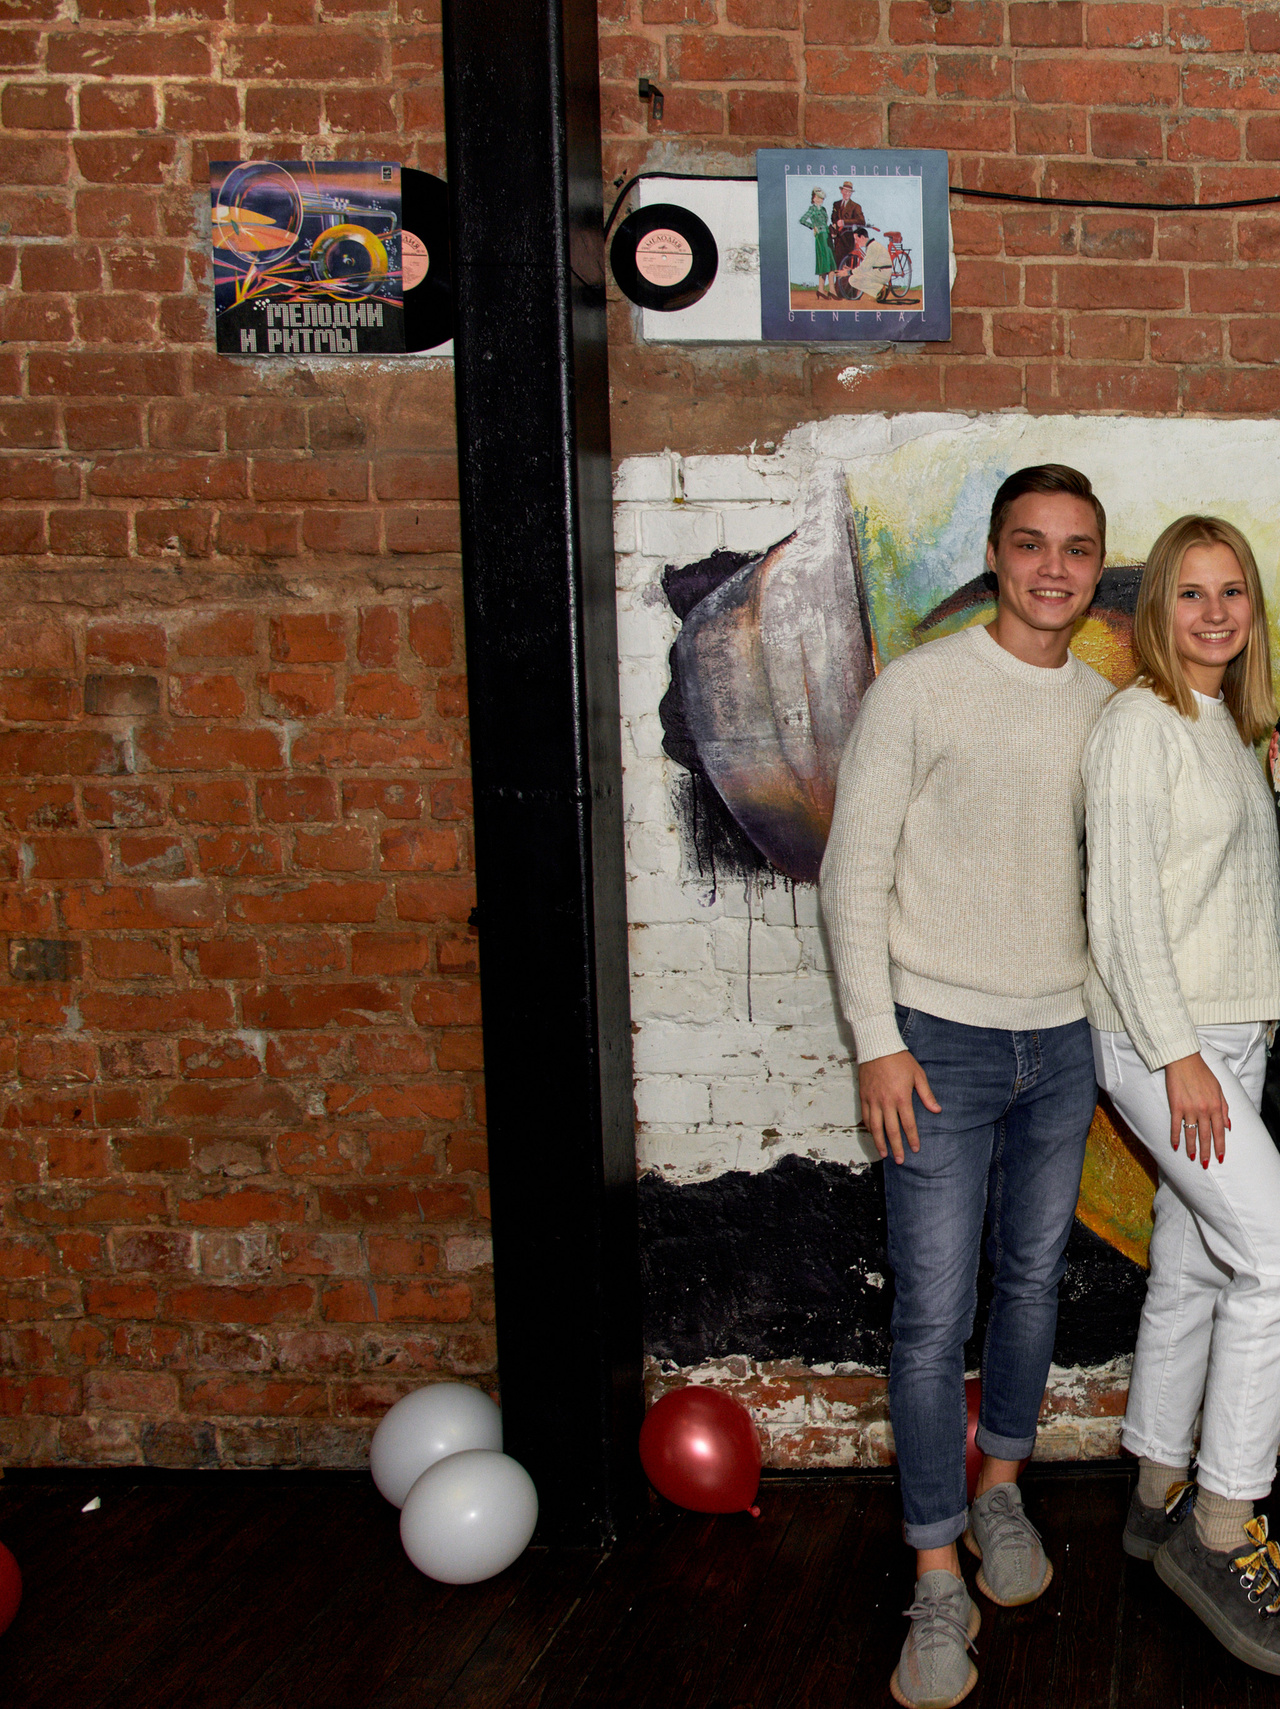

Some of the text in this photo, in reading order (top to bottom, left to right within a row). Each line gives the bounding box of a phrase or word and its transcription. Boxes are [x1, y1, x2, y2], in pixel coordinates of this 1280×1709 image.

[784, 164, 923, 176] PIROS BICIKLI
[266, 303, 384, 329] МЕЛОДИИ
[239, 328, 358, 353] И РИТМЫ
